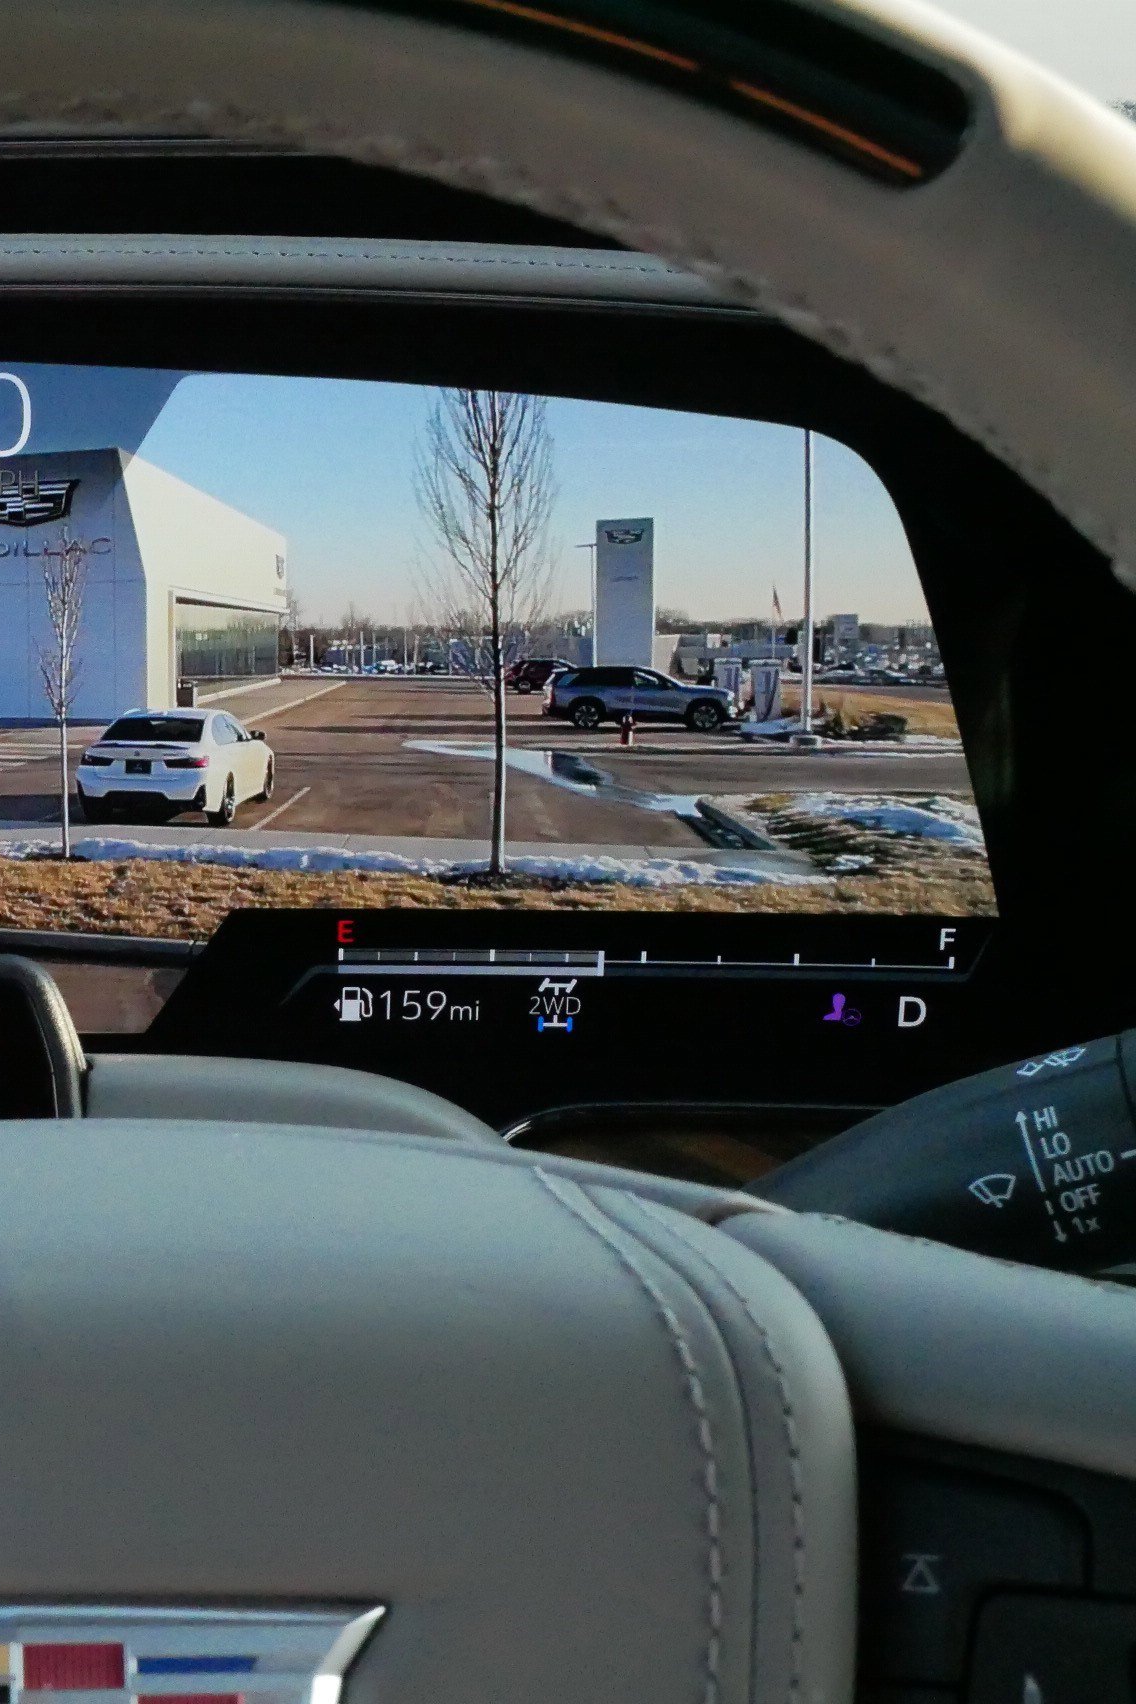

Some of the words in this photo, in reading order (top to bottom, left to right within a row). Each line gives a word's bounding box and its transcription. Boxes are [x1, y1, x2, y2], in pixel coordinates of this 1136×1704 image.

[337, 920, 355, 943] E
[938, 927, 957, 951] F
[528, 995, 581, 1016] 2WD
[897, 995, 927, 1028] D
[1033, 1104, 1059, 1132] HI
[1039, 1132, 1072, 1160] LO
[1052, 1150, 1115, 1186] AUTO
[1060, 1183, 1102, 1212] OFF
